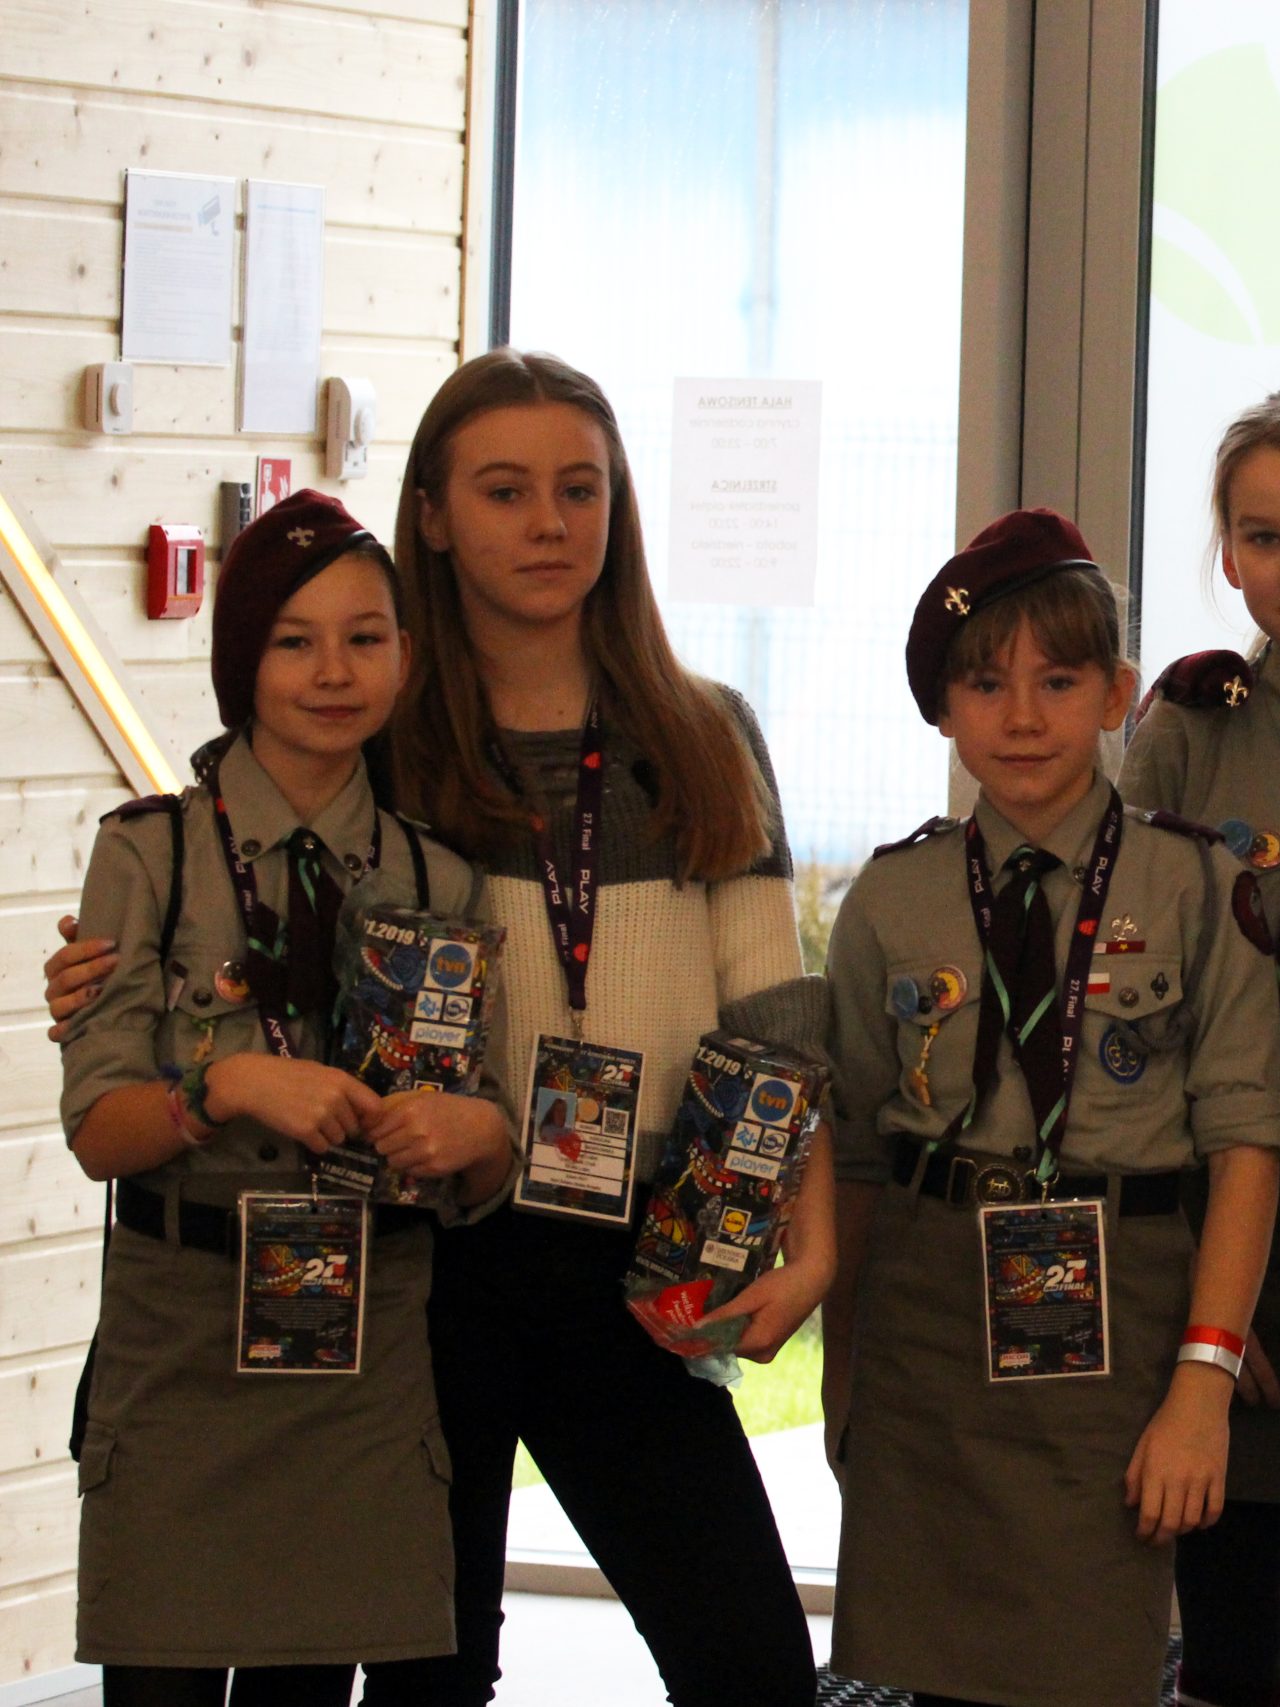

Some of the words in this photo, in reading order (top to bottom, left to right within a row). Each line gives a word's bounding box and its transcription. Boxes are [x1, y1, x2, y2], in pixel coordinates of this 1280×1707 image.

[581, 828, 592, 851] Final
[545, 859, 563, 905] PLAY
[971, 858, 985, 895] PLAY
[1091, 855, 1108, 897] PLAY
[579, 868, 591, 915] PLAY
[364, 919, 417, 946] 1.2019
[1066, 996, 1079, 1018] Final
[415, 1027, 462, 1043] player
[601, 1062, 634, 1082] 27
[758, 1090, 788, 1110] tvn
[729, 1153, 774, 1176] player
[302, 1254, 349, 1282] 27
[1044, 1259, 1087, 1289] 27
